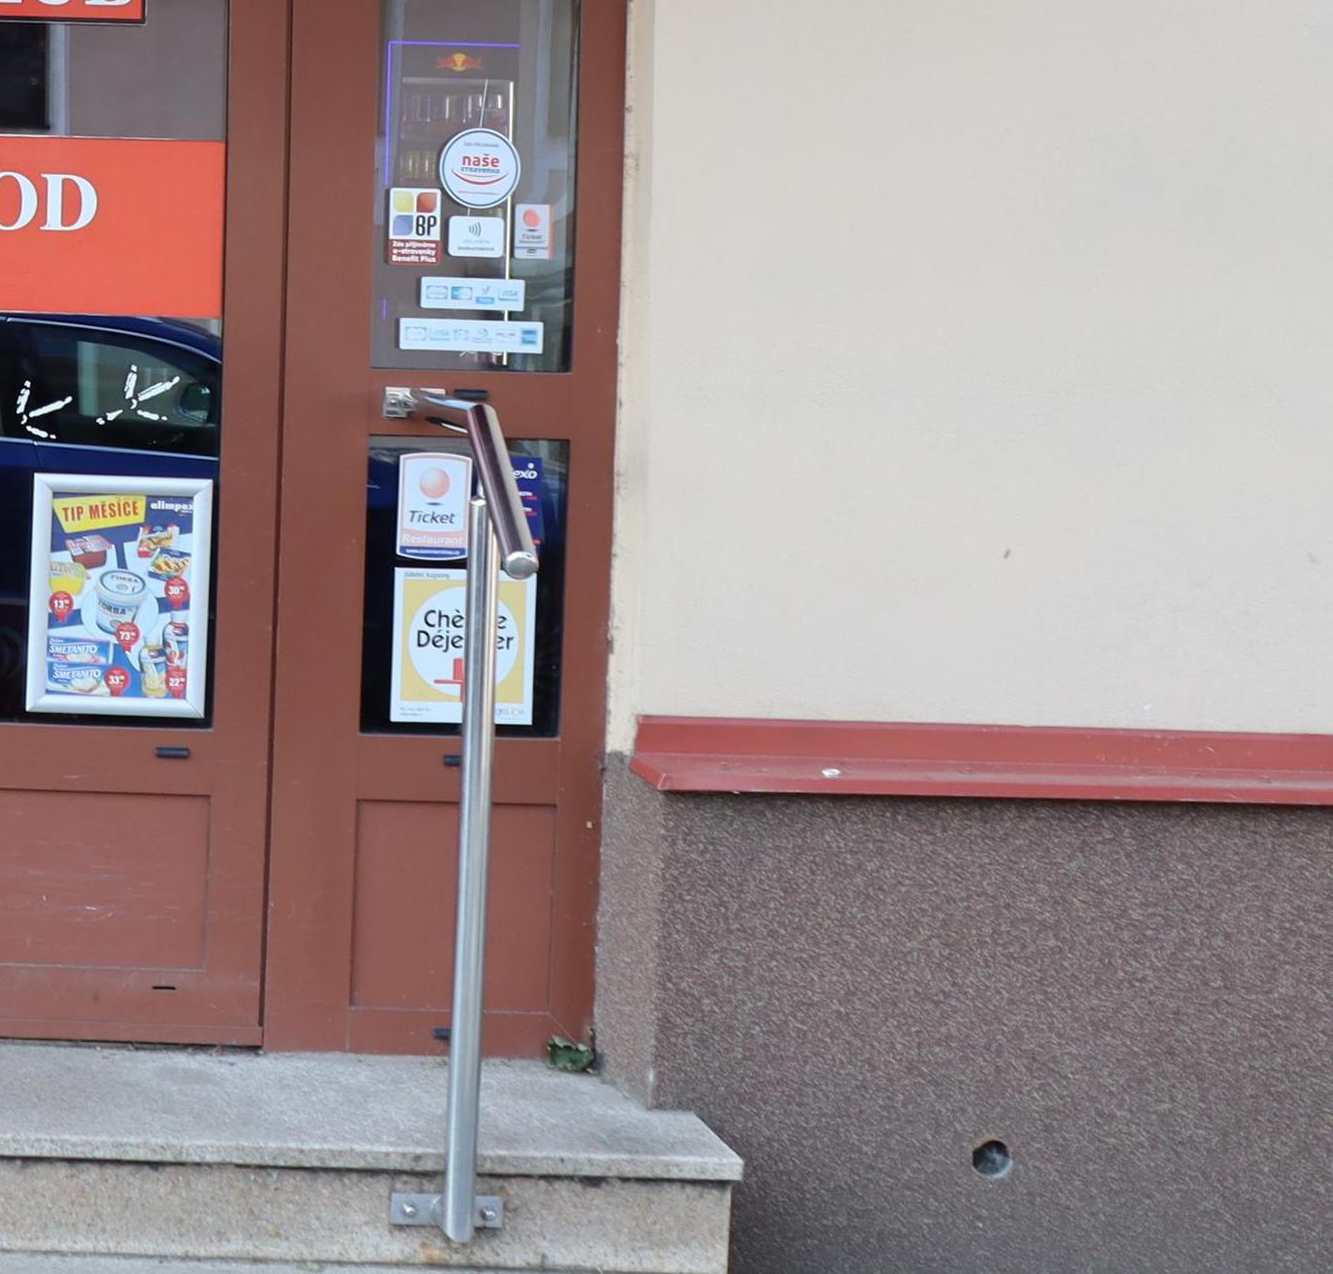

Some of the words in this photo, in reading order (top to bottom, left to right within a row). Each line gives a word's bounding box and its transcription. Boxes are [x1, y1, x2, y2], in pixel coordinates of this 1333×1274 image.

[462, 153, 500, 168] naše
[416, 215, 437, 236] BP
[62, 506, 83, 522] TIP
[89, 500, 139, 518] MĚSÍCE
[409, 510, 456, 524] Ticket
[403, 533, 463, 545] Restaurant
[423, 609, 507, 629] Chèe
[417, 630, 515, 652] Déjeer
